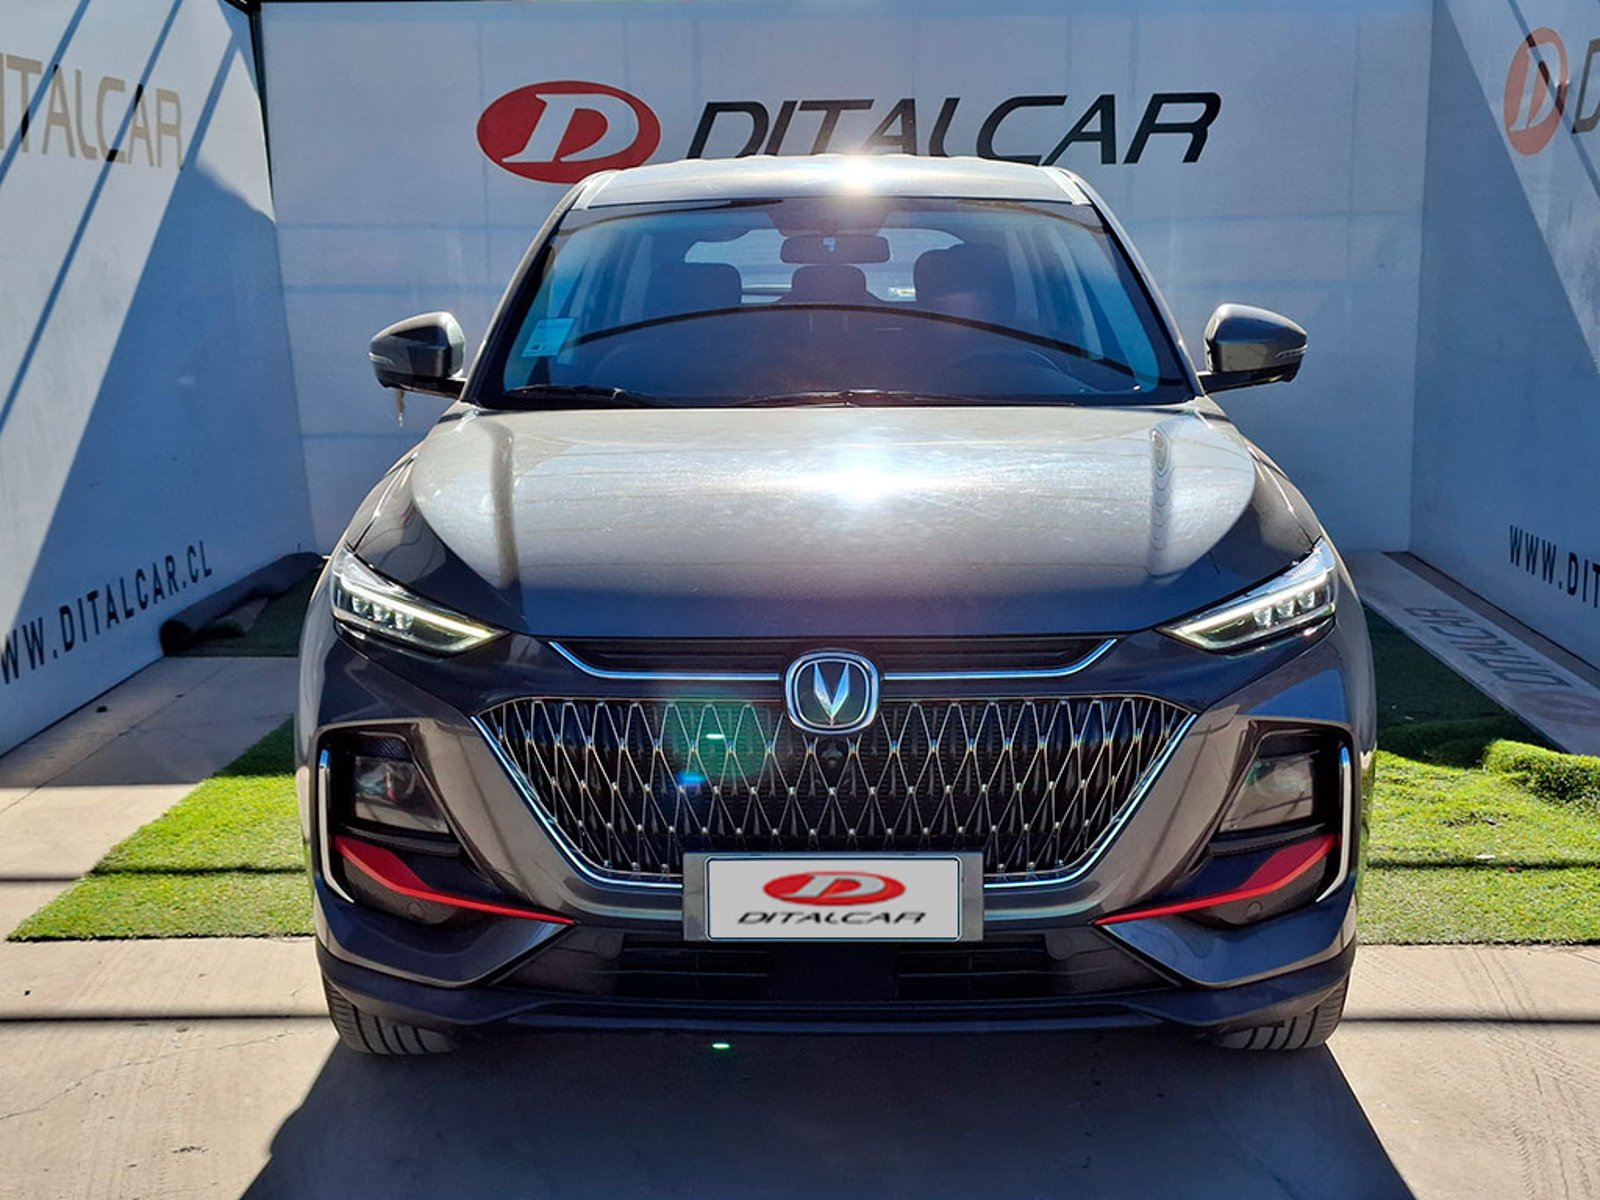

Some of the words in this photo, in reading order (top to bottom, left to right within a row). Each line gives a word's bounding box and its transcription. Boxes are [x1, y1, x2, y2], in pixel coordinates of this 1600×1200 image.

[0, 52, 183, 169] ITALCAR
[501, 93, 640, 163] D
[686, 92, 1221, 166] DITALCAR
[779, 874, 887, 898] D
[736, 911, 927, 925] DITALCAR
